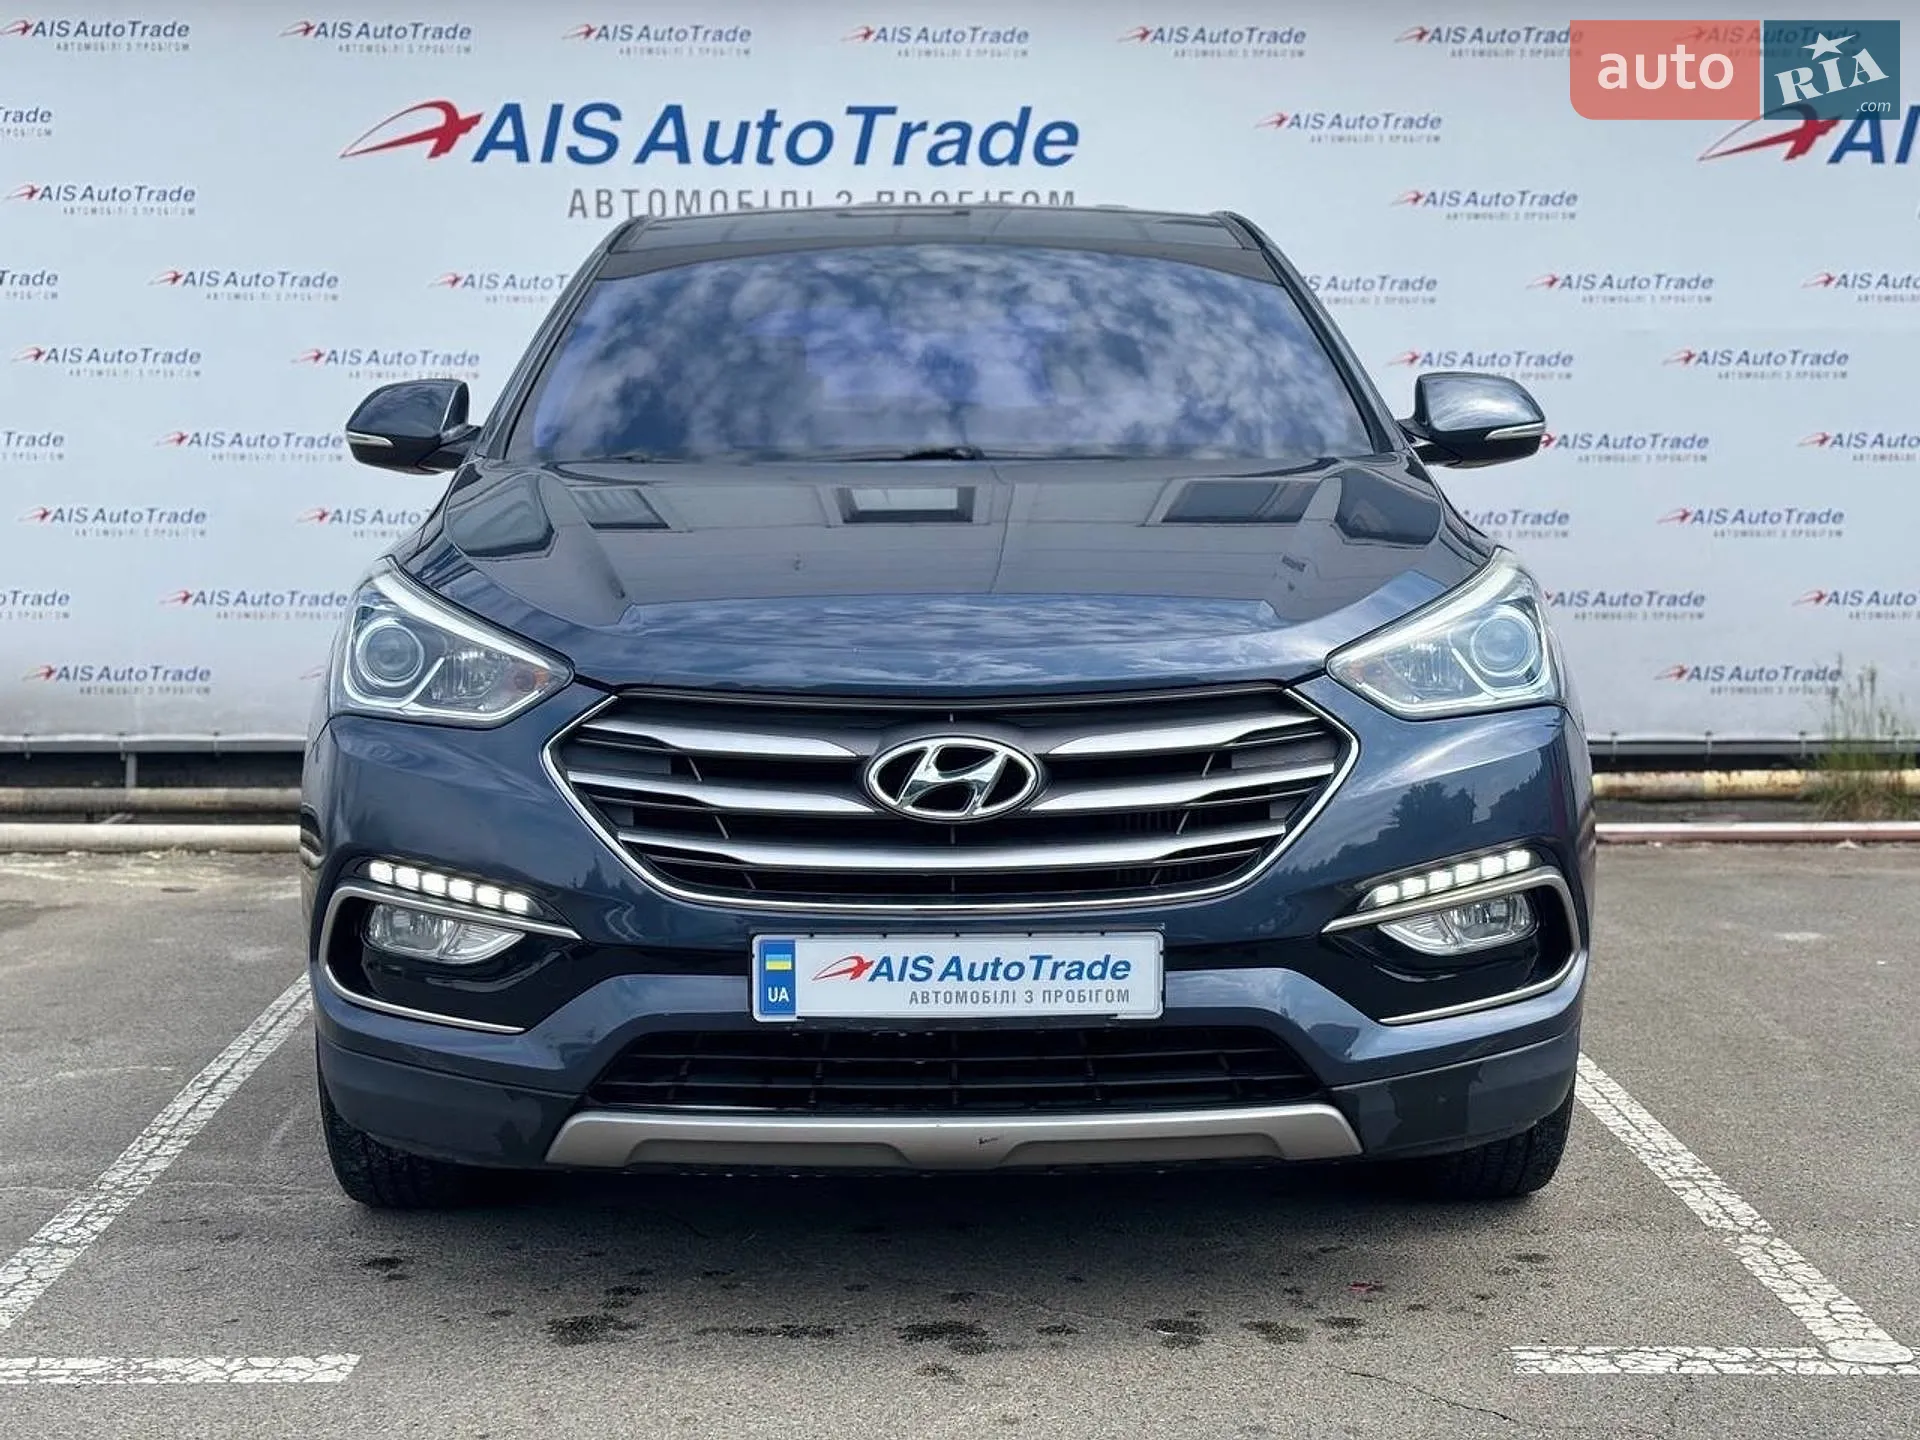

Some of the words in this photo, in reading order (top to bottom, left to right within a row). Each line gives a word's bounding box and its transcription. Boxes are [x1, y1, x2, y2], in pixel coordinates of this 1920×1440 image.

[32, 20, 71, 37] AIS
[73, 20, 190, 37] AutoTrade
[314, 22, 352, 40] AIS
[354, 22, 472, 40] AutoTrade
[597, 24, 634, 42] AIS
[636, 24, 752, 42] AutoTrade
[874, 26, 911, 44] AIS
[913, 26, 1029, 44] AutoTrade
[1150, 26, 1189, 44] AIS
[1191, 26, 1306, 44] AutoTrade
[1428, 26, 1466, 44] AIS
[1286, 113, 1325, 130] AIS
[1327, 113, 1442, 130] AutoTrade
[472, 102, 622, 165] AIS
[633, 104, 1079, 167] AutoTrade
[39, 185, 77, 202] AIS
[79, 185, 196, 202] AutoTrade
[1422, 190, 1461, 207] AIS
[1463, 190, 1578, 207] AutoTrade
[183, 271, 222, 288] AIS
[224, 271, 339, 288] AutoTrade
[462, 273, 499, 289] AIS
[1325, 274, 1437, 292] AutoTrade
[1558, 273, 1597, 290] AIS
[1599, 273, 1714, 290] AutoTrade
[1834, 272, 1872, 289] AIS
[46, 348, 84, 365] AIS
[86, 348, 201, 365] AutoTrade
[325, 349, 362, 366] AIS
[364, 349, 480, 366] AutoTrade
[1419, 350, 1457, 367] AIS
[1459, 350, 1574, 367] AutoTrade
[1695, 349, 1733, 366] AIS
[1735, 349, 1849, 366] AutoTrade
[188, 432, 226, 449] AIS
[228, 432, 343, 449] AutoTrade
[1555, 432, 1593, 449] AIS
[1595, 432, 1710, 449] AutoTrade
[1828, 431, 1868, 448] AIS
[51, 507, 90, 524] AIS
[92, 507, 207, 524] AutoTrade
[329, 508, 366, 524] AIS
[369, 508, 430, 525] Auto
[1690, 507, 1728, 525] AIS
[1730, 507, 1845, 525] AutoTrade
[192, 590, 231, 607] AIS
[233, 590, 347, 607] AutoTrade
[1549, 590, 1589, 608] AIS
[1591, 590, 1706, 608] AutoTrade
[1825, 590, 1864, 606] AIS
[56, 665, 94, 682] AIS
[96, 665, 212, 682] AutoTrade
[1686, 665, 1725, 682] AIS
[867, 956, 934, 982] AIS
[937, 954, 1131, 982] AutoTrade
[767, 987, 790, 1003] UA
[909, 989, 1017, 1006] АВТОМОБІЛІ
[1043, 988, 1130, 1004] ПРОБІГОМ
